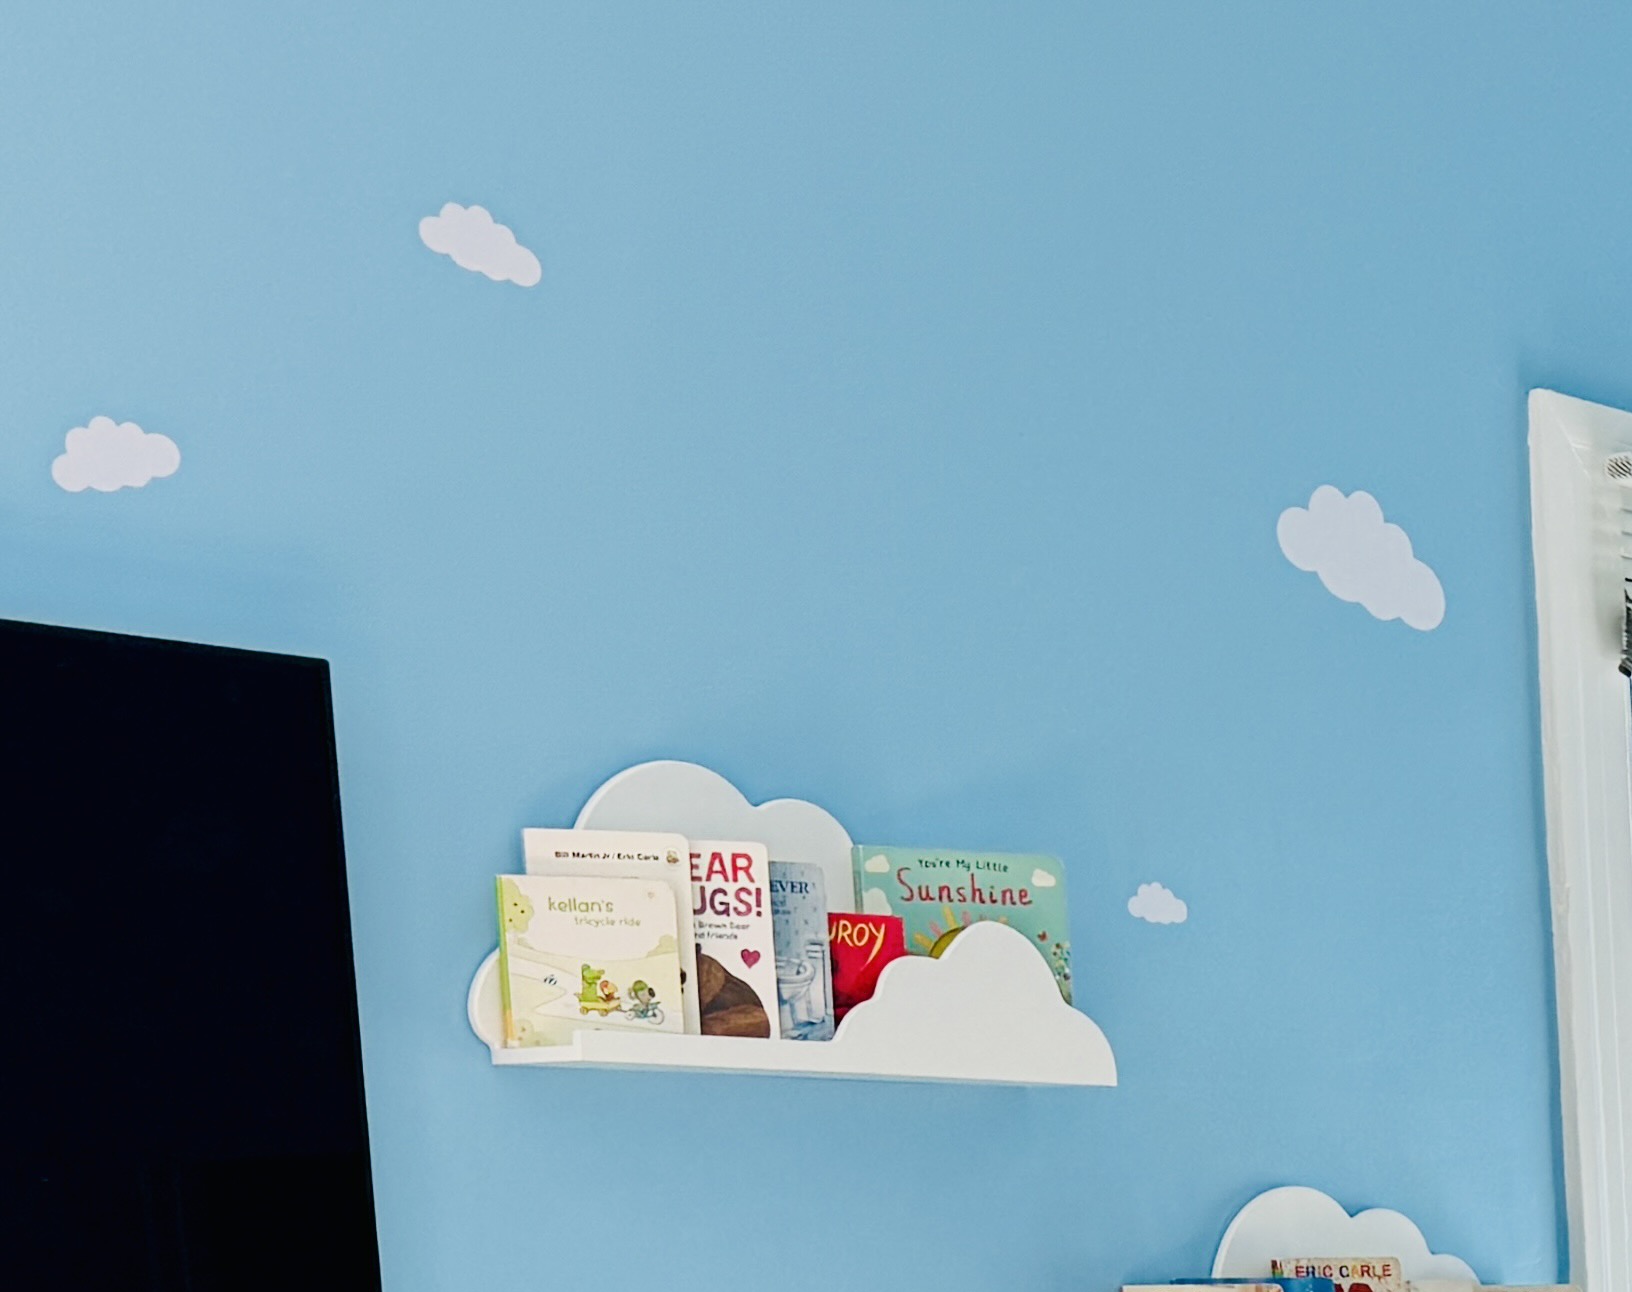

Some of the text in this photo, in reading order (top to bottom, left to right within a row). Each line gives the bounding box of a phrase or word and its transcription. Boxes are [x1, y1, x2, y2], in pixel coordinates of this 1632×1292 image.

[956, 858, 971, 872] My
[975, 860, 1009, 873] Little
[897, 867, 1033, 906] Sunshine
[548, 896, 614, 913] kellan's
[574, 916, 641, 928] tricycle ride
[1295, 1263, 1392, 1278] ERIC CARLE
